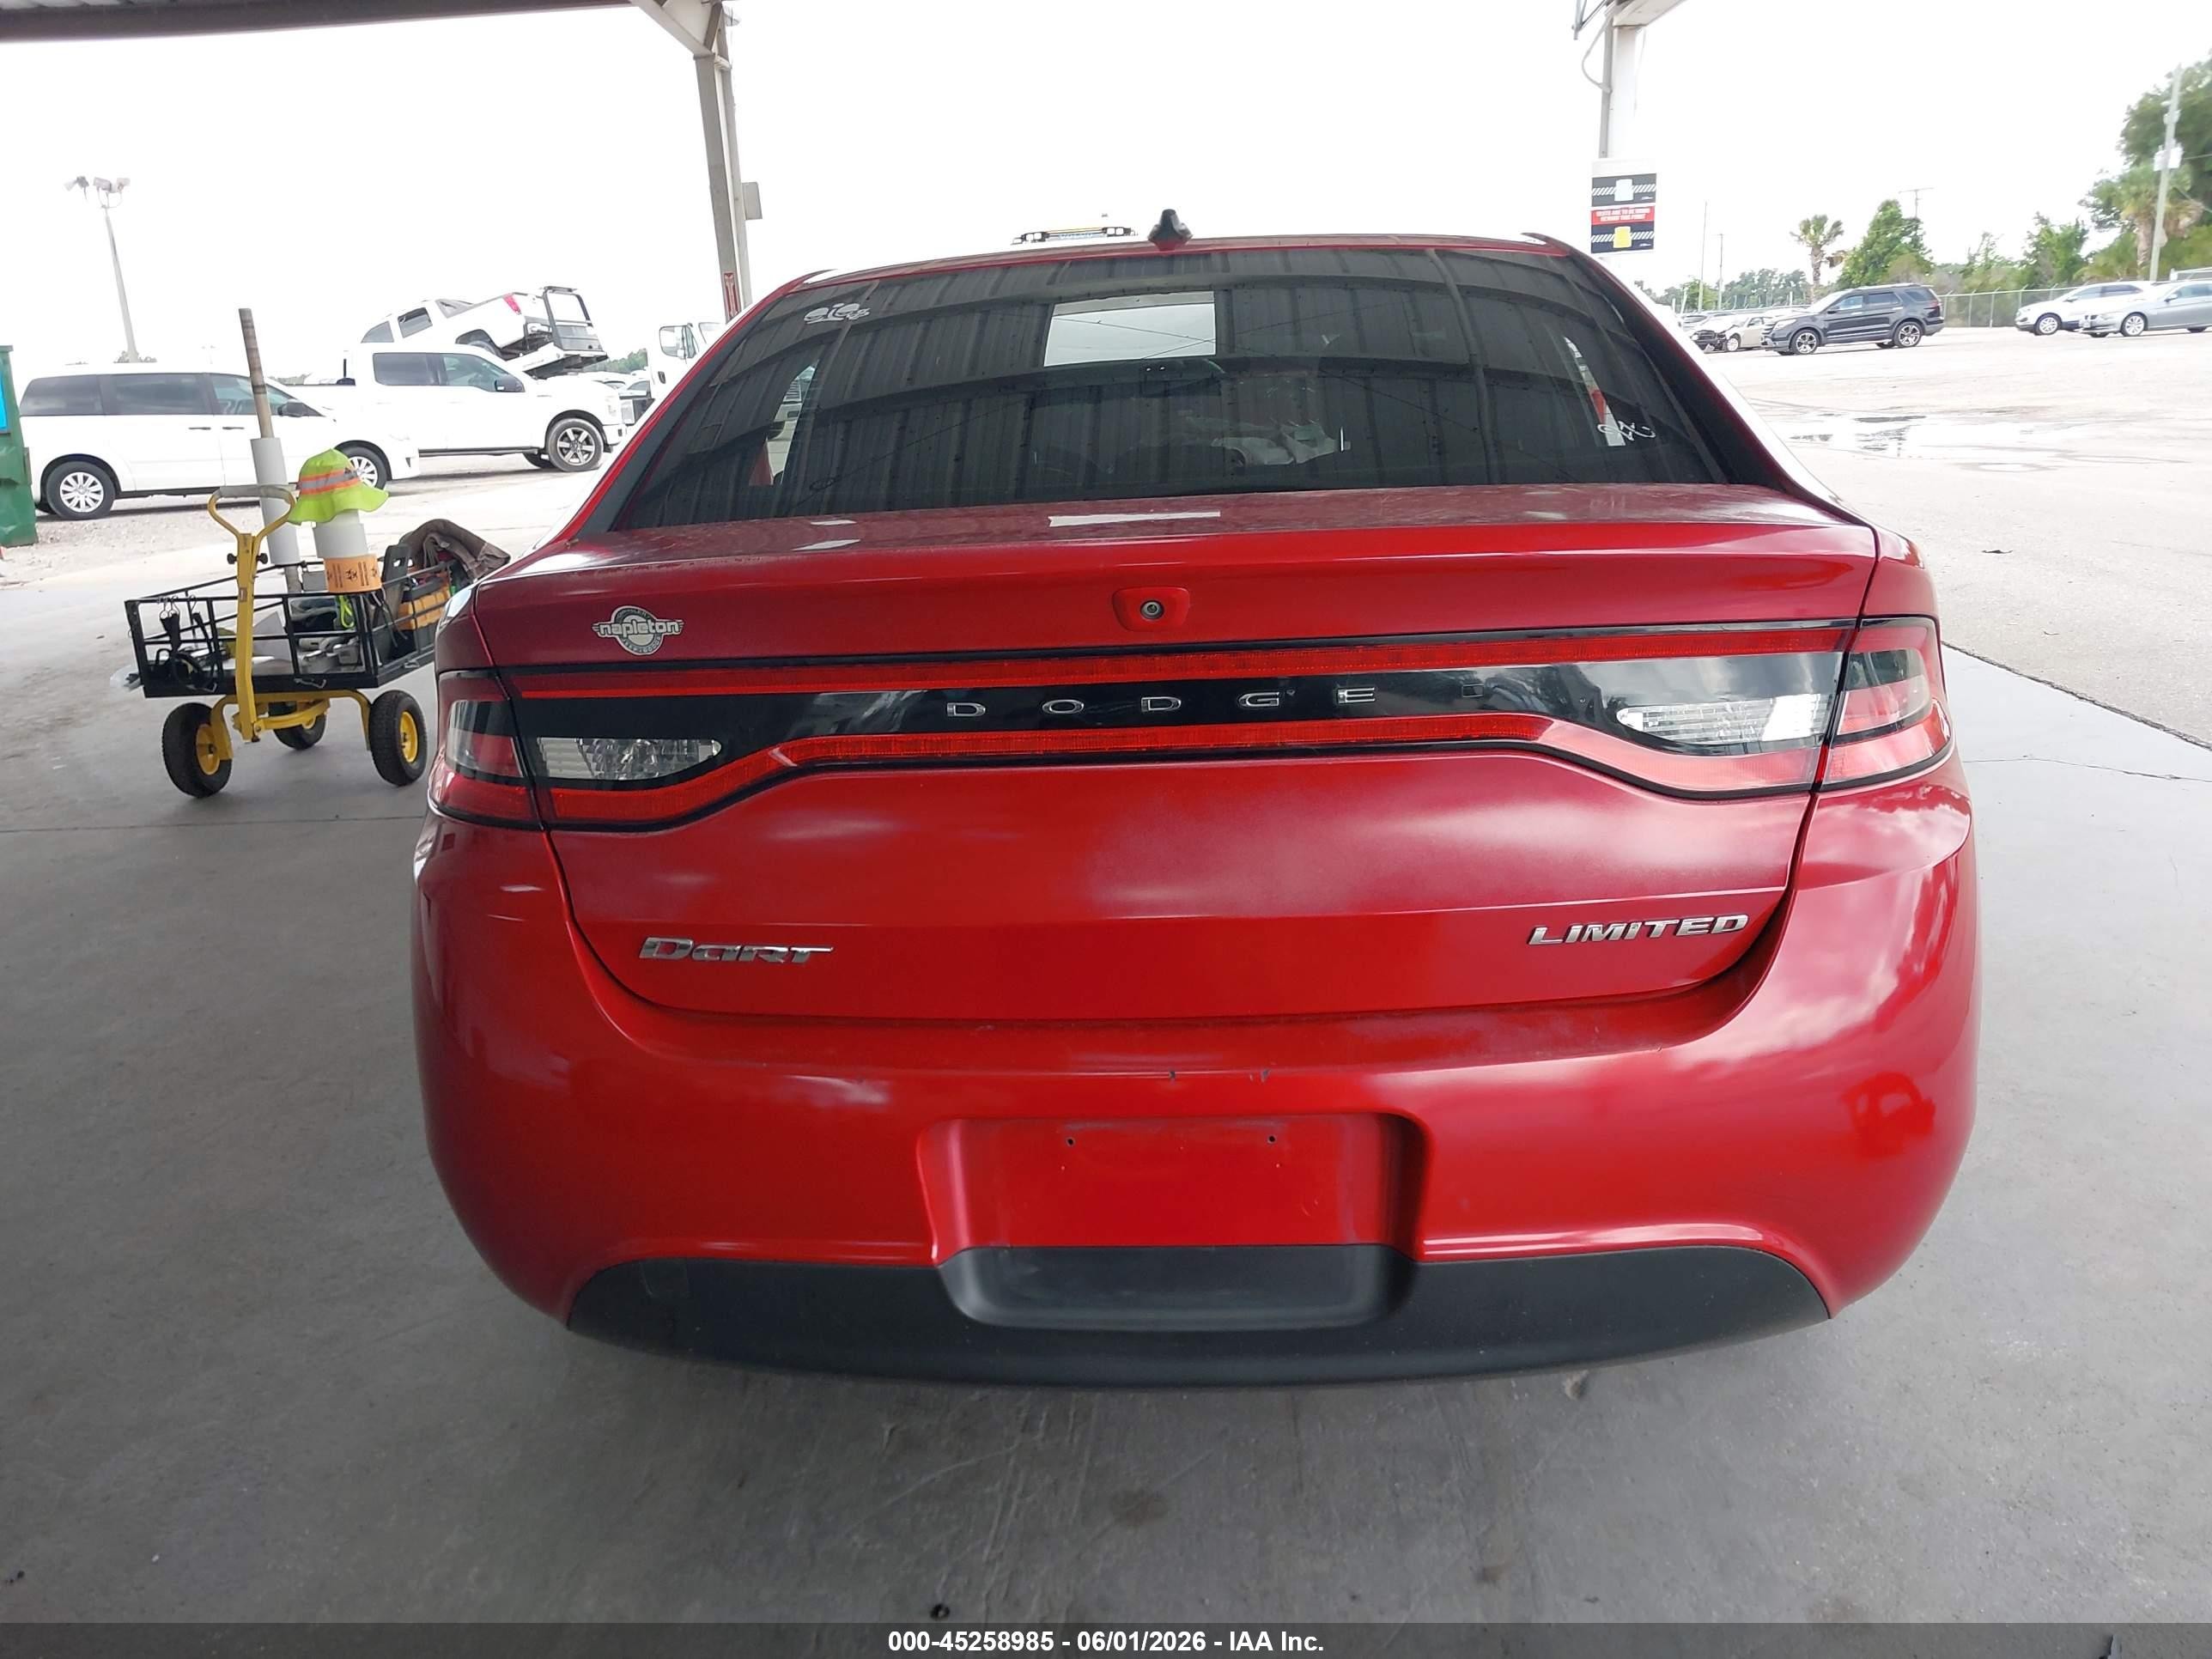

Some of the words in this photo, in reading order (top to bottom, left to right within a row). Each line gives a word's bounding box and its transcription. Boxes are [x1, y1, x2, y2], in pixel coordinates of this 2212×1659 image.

[599, 619, 679, 638] napleton
[946, 687, 1376, 718] DODGE
[1527, 914, 1750, 945] LIMITED
